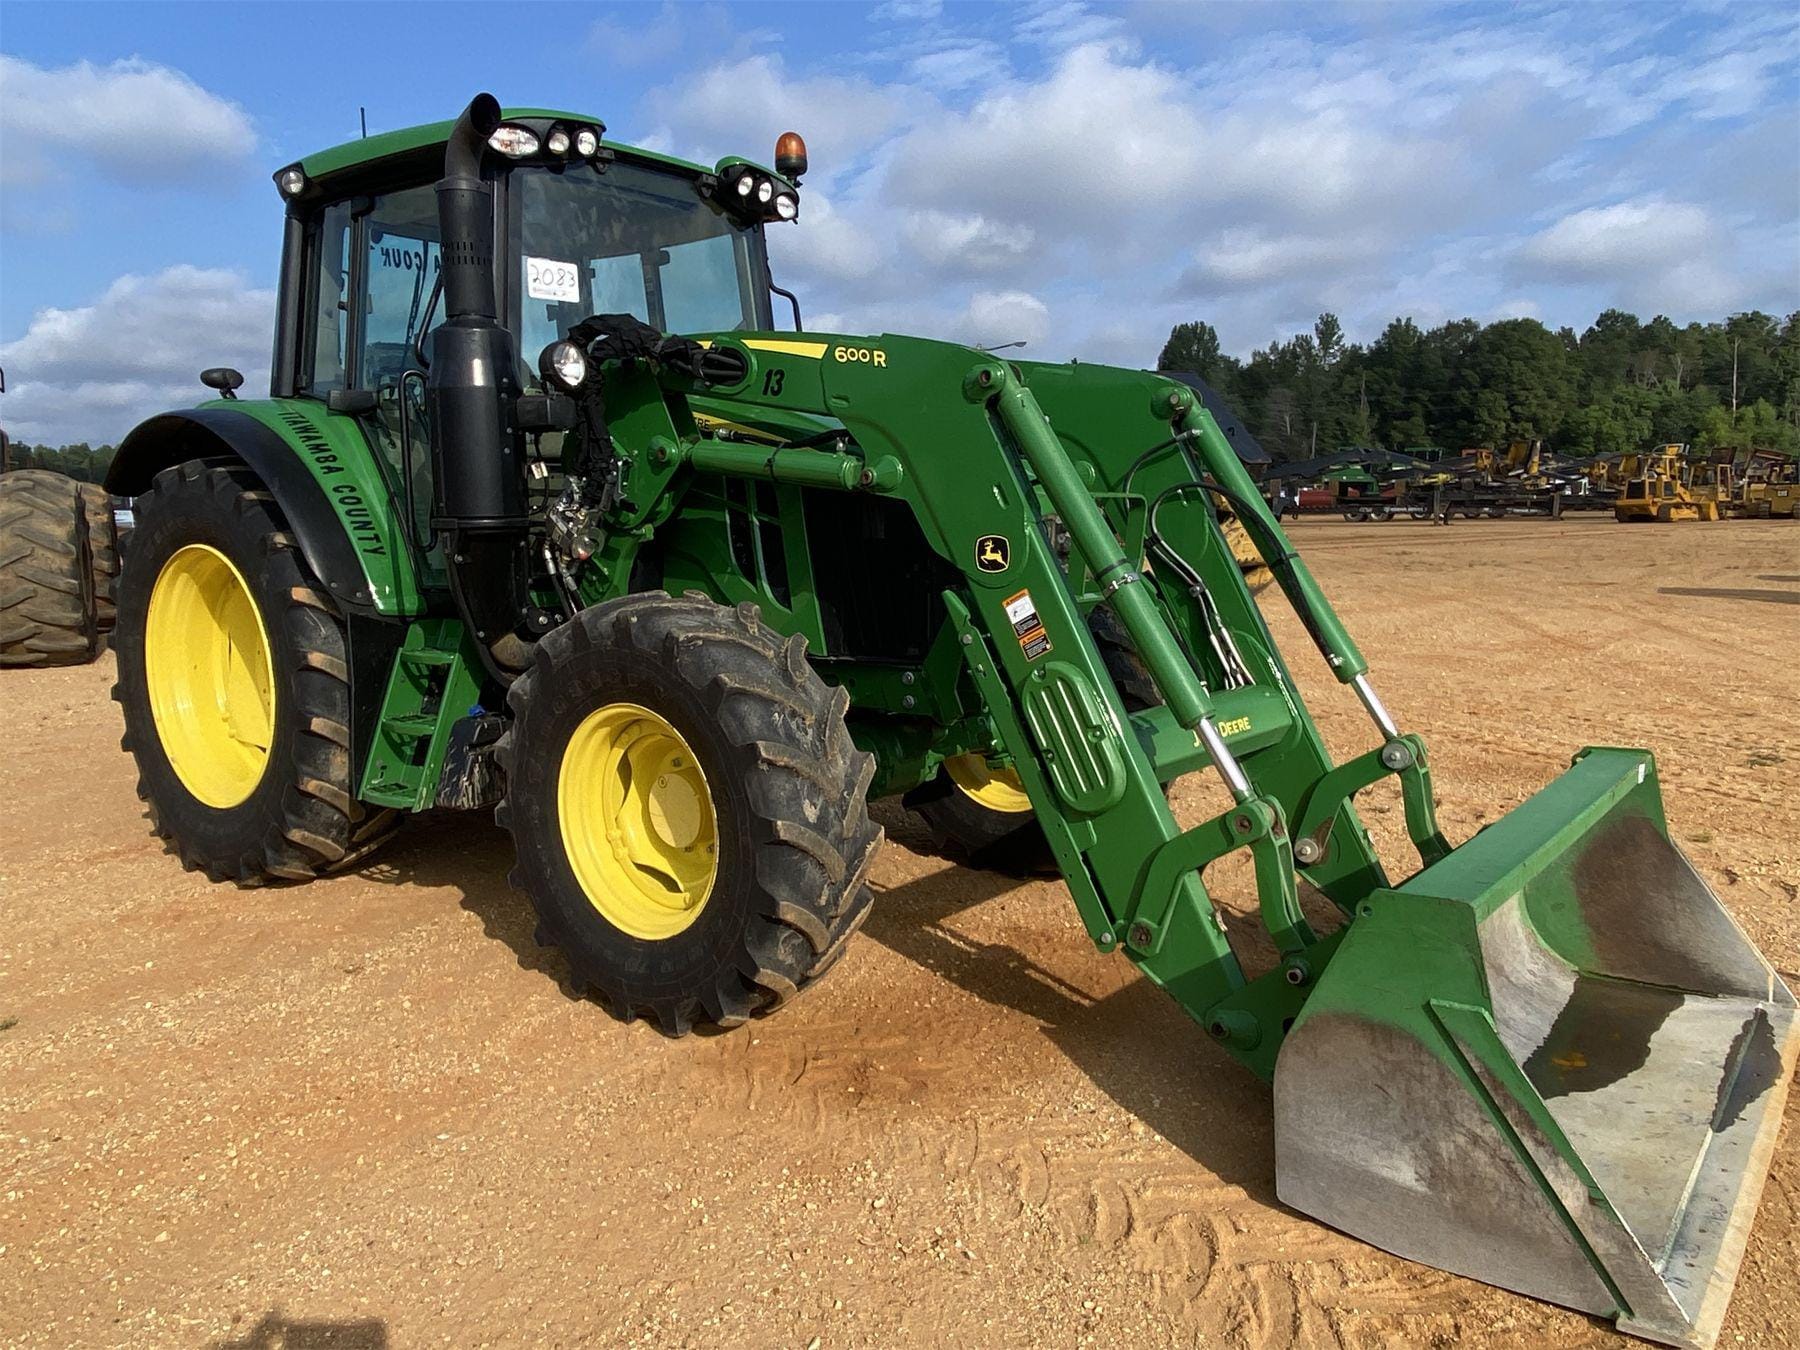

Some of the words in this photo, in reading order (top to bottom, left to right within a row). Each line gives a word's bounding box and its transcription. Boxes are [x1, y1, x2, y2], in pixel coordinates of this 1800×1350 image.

[530, 264, 576, 288] 2083
[762, 368, 786, 396] 13
[278, 411, 345, 475] ITAWAMBA
[332, 484, 387, 556] COUNTY
[1218, 717, 1251, 738] DEERE
